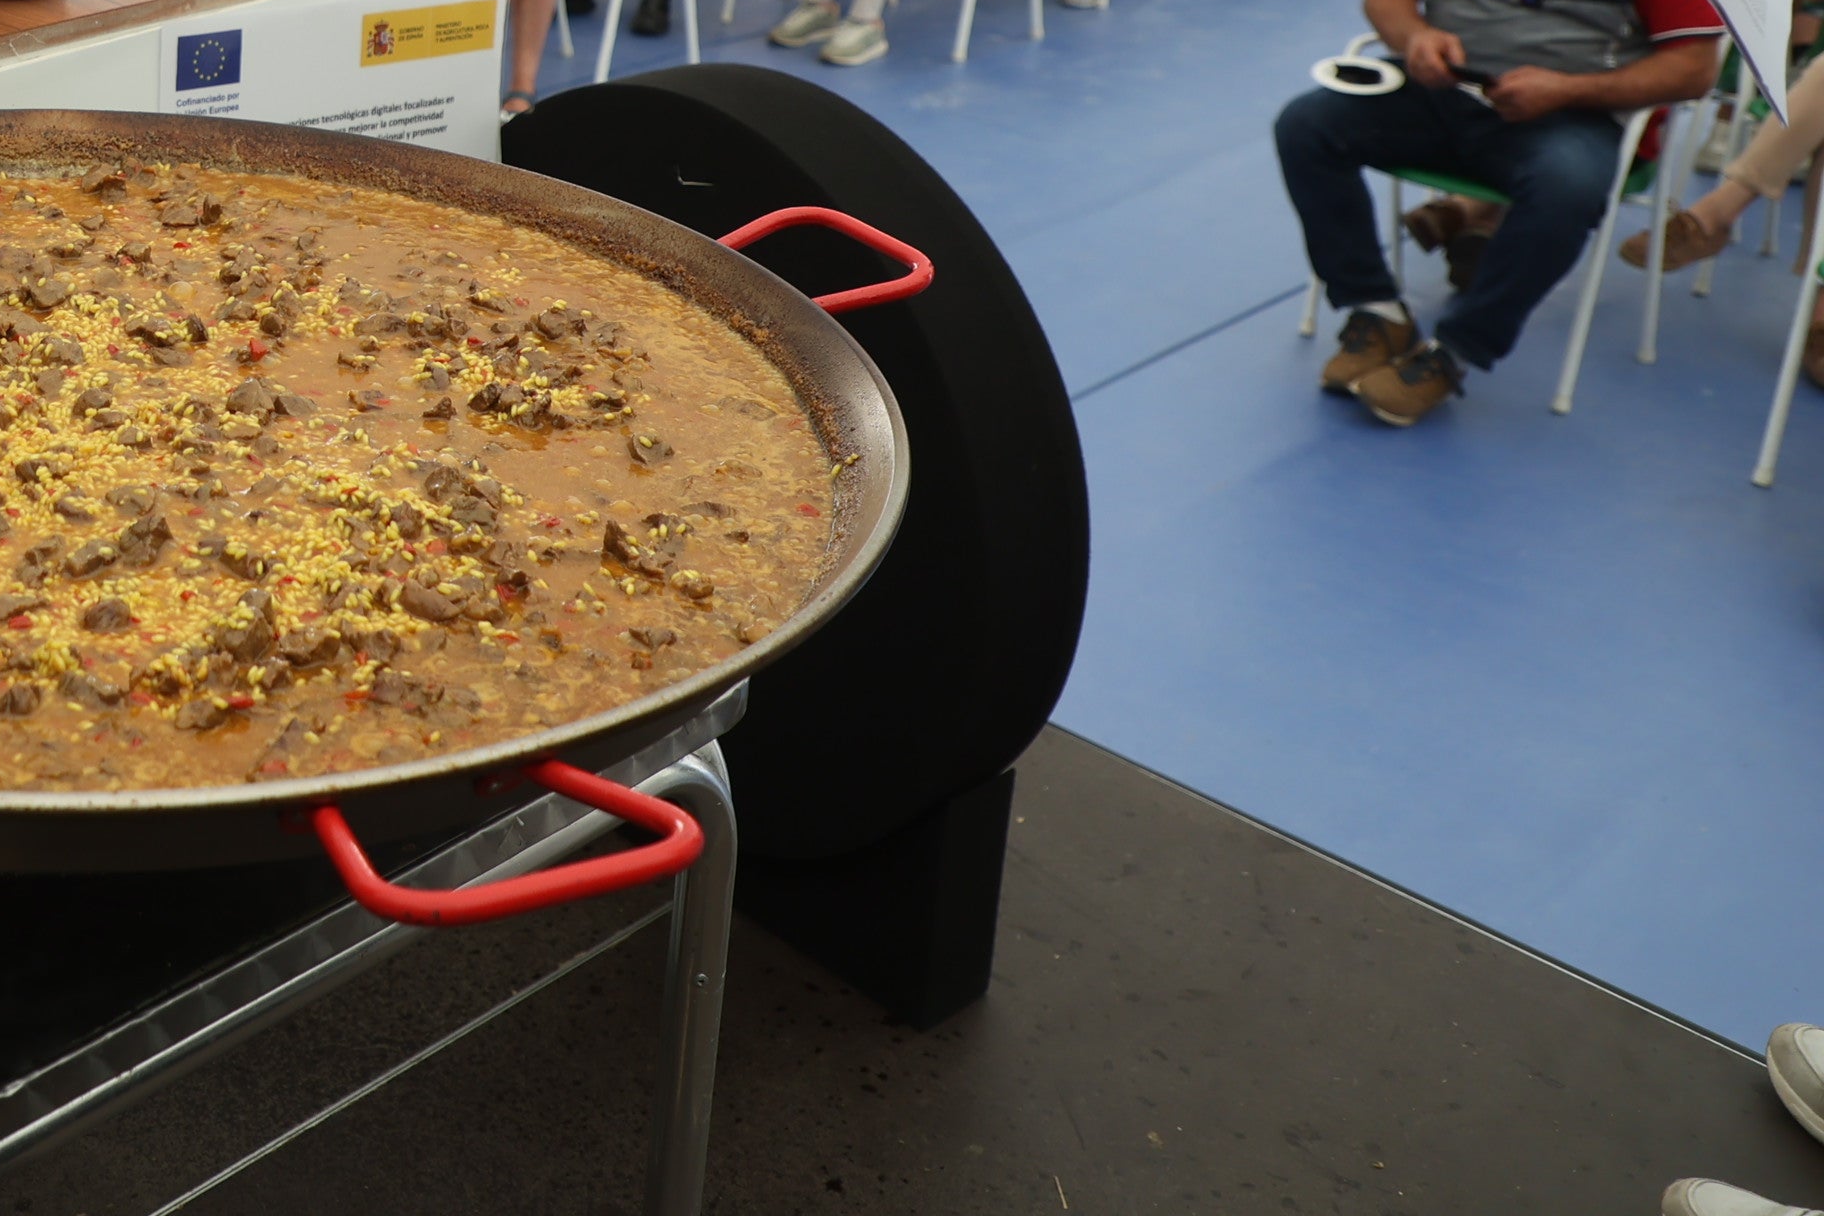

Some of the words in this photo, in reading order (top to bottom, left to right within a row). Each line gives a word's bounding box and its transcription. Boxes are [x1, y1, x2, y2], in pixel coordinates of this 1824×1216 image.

[176, 92, 226, 107] Cofinanciado
[227, 92, 240, 102] por
[209, 104, 239, 115] Europea
[321, 108, 370, 124] tecnológicas
[371, 103, 402, 116] digitales
[404, 97, 445, 110] focalizadas
[446, 96, 454, 104] en
[348, 122, 379, 135] mejorar
[380, 120, 386, 128] la
[388, 110, 444, 128] competitividad
[412, 125, 448, 139] promover
